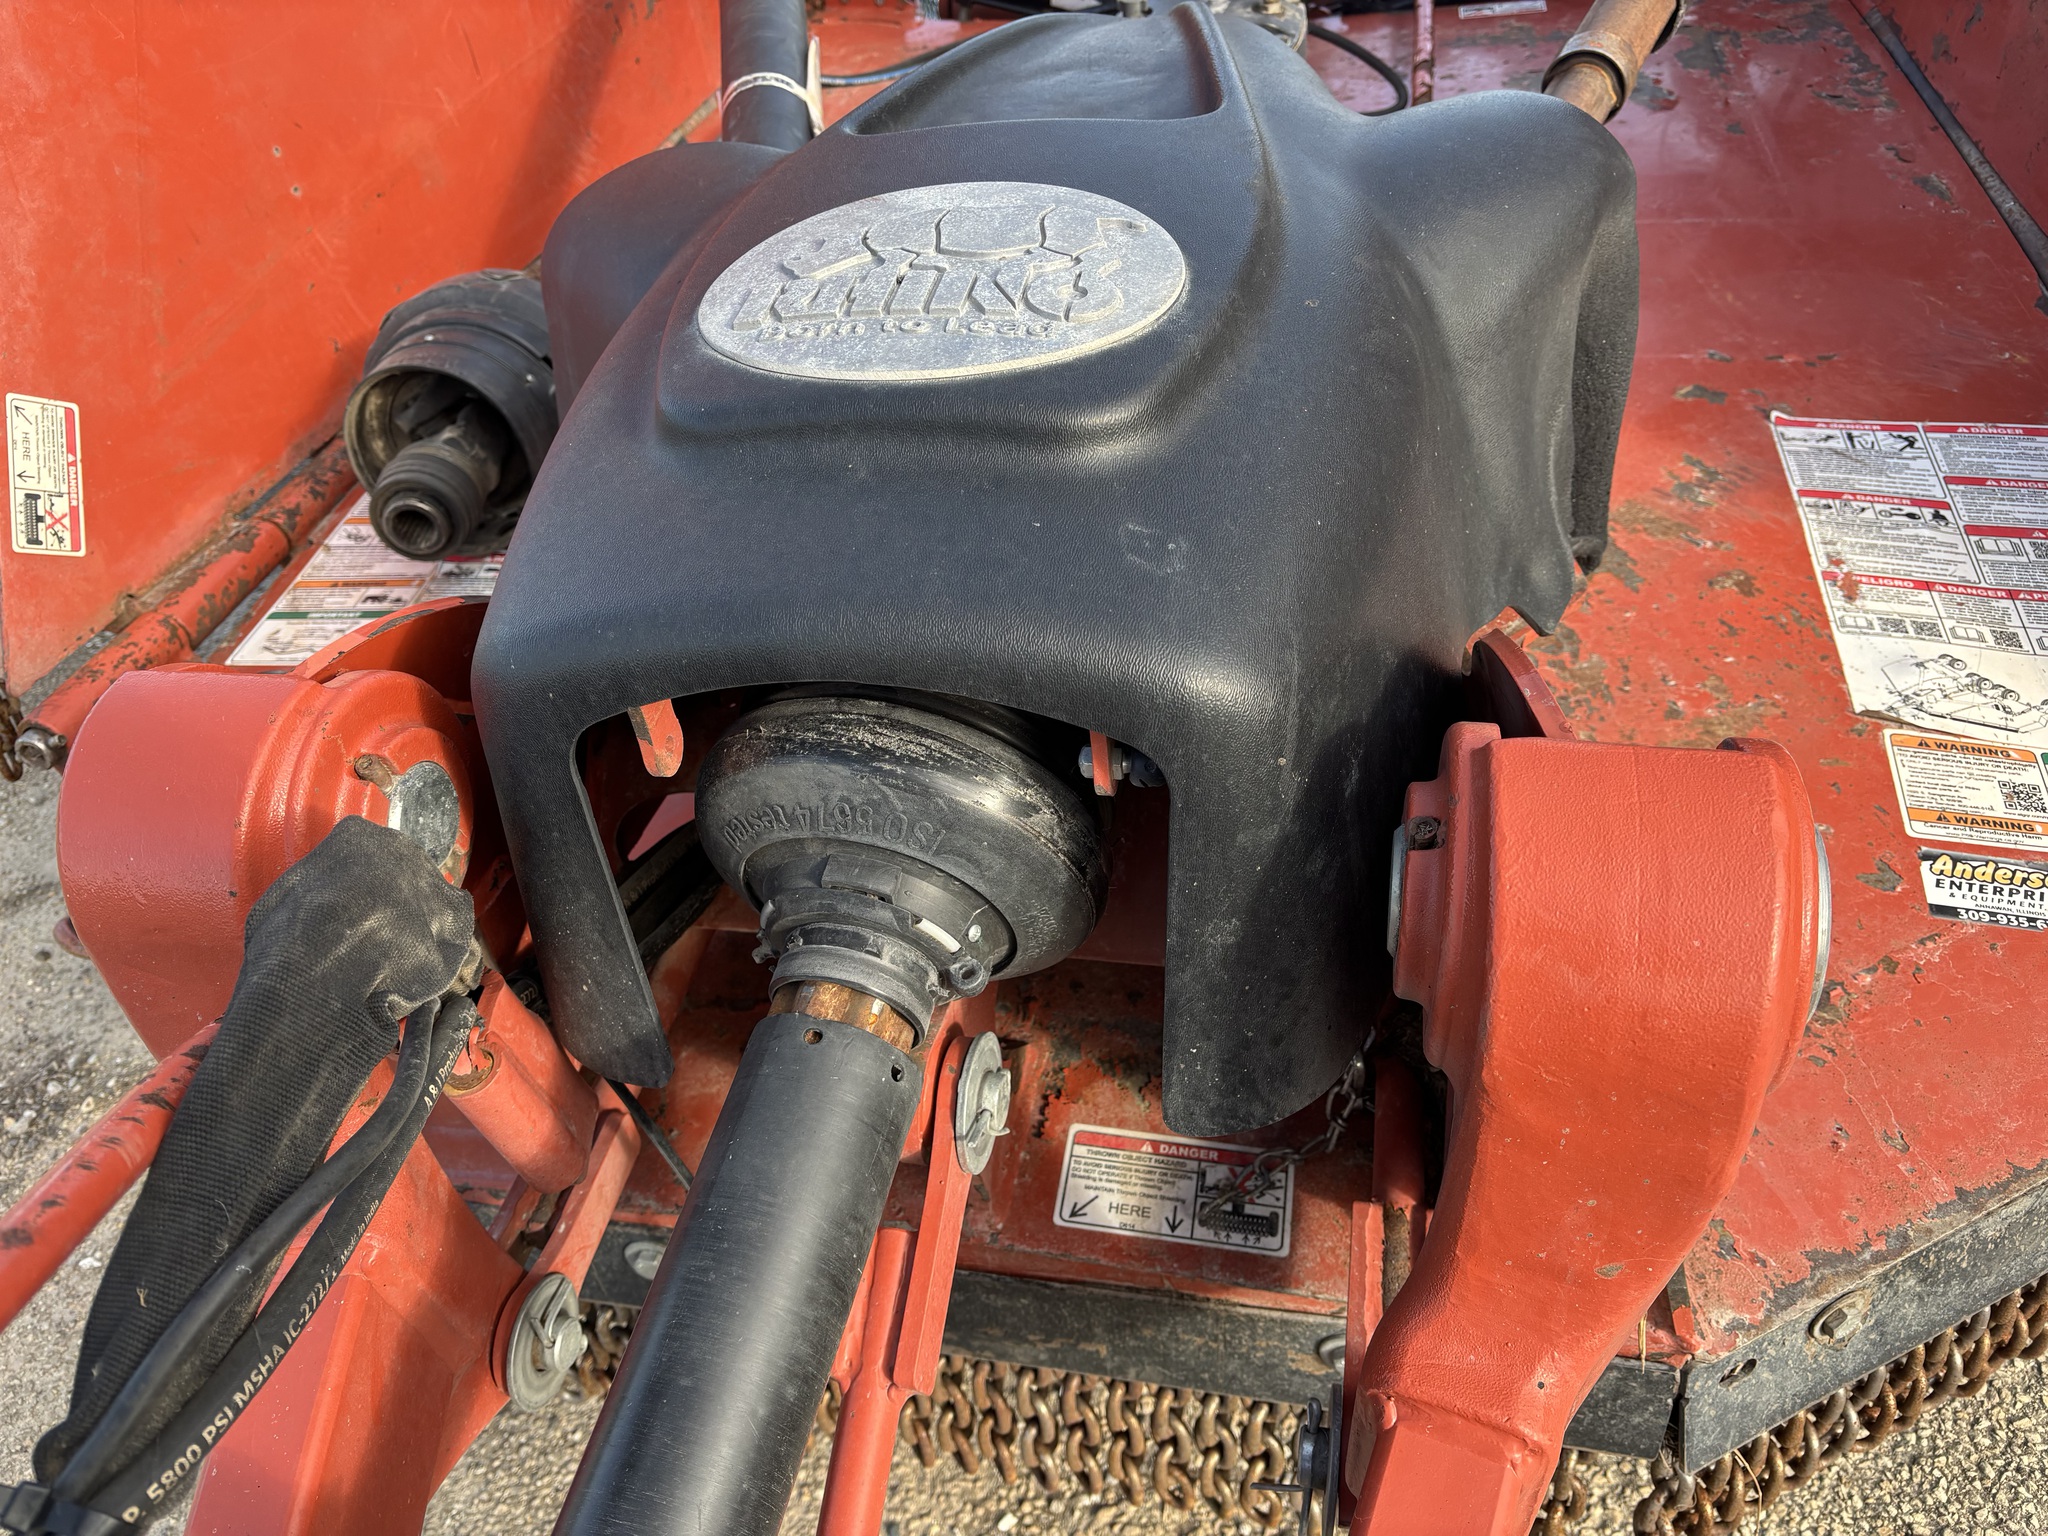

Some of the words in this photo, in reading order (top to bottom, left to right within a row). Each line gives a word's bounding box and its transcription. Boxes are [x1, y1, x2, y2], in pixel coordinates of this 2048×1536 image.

[881, 317, 932, 334] to
[1828, 423, 1882, 431] DANGER
[1970, 427, 2024, 435] DANGER
[22, 432, 31, 462] HERE
[68, 466, 78, 507] DANGER
[2000, 480, 2048, 489] DANGE
[1856, 494, 1912, 505] DANGER
[1947, 585, 2008, 598] DANGER
[1934, 741, 2012, 758] WARNING
[1953, 815, 2035, 832] WARNING
[1930, 853, 2048, 889] Anders
[428, 1084, 439, 1099] &
[424, 1095, 433, 1112] A
[1086, 1148, 1121, 1159] THROWN
[1122, 1153, 1153, 1163] OBJECT
[1154, 1157, 1188, 1168] HAZARD
[1159, 1143, 1219, 1161] DANGER
[1083, 1161, 1103, 1169] AVOID
[1104, 1163, 1133, 1173] SERIOUS
[1083, 1167, 1096, 1175] NOT
[1097, 1169, 1128, 1179] OPERATE
[364, 1200, 380, 1225] India
[1107, 1201, 1152, 1219] HERE
[145, 1443, 202, 1505] 5800
[202, 1405, 234, 1445] PSI
[232, 1344, 286, 1408] MSHA
